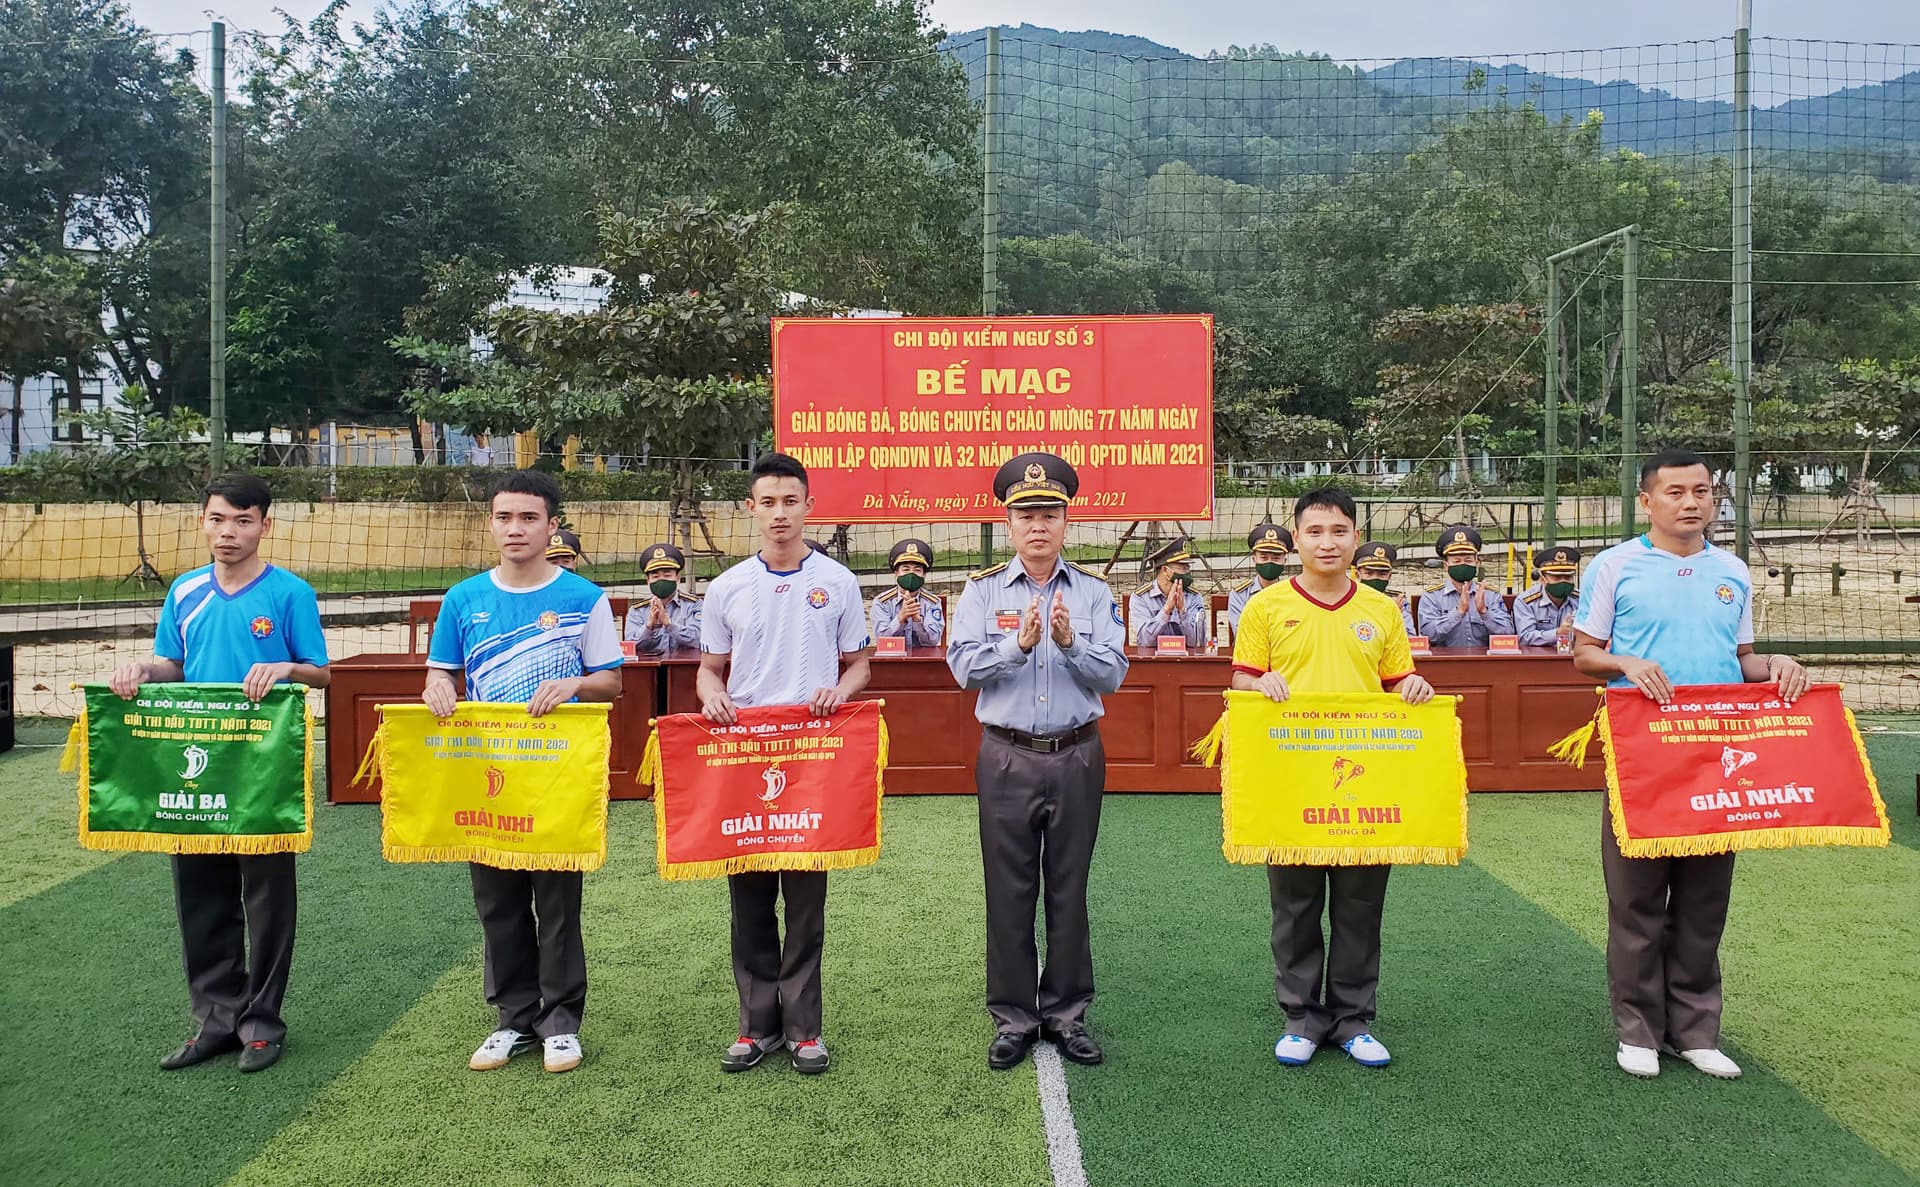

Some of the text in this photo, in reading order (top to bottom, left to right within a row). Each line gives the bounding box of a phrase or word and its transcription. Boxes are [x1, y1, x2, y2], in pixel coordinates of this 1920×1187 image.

[893, 325, 1094, 350] CHI ĐỘI KIỂM NGƯ SỐ 3
[916, 360, 1071, 400] BẾ MẠC
[791, 402, 1198, 435] GIẢI BÓNG ĐÁ, BÓNG CHUYỀN CHÀO MỪNG 77 NĂM NGÀY
[837, 442, 865, 472] LẬP
[869, 446, 930, 470] QĐNDVN
[933, 441, 953, 467] VÀ
[957, 446, 975, 467] 32
[979, 440, 1013, 467] NĂM
[1061, 440, 1085, 471] HỘI
[1089, 444, 1127, 469] QPTD
[1131, 439, 1166, 466] NĂM
[1169, 443, 1204, 466] 2021
[863, 494, 883, 509] Đà
[888, 490, 930, 512] Nẵng,
[935, 494, 968, 511] ngày
[973, 493, 988, 508] 13
[1092, 491, 1127, 507] 2021
[253, 703, 260, 711] 3
[1282, 711, 1299, 719] CHI
[1660, 703, 1679, 713] CHI
[1681, 703, 1702, 713] ĐỘI
[1737, 702, 1760, 711] NGƯ
[1763, 700, 1780, 709] SỐ
[124, 712, 142, 726] GIẢI
[144, 715, 162, 727] THI
[188, 717, 218, 730] TDTT
[220, 717, 247, 731] NĂM
[249, 718, 273, 731] 2021
[710, 726, 727, 735] CHI
[1649, 717, 1672, 733] GIẢI
[1674, 719, 1695, 731] THI
[1721, 718, 1751, 731] TDTT
[1754, 715, 1785, 730] NĂM
[1786, 715, 1813, 727] 2021
[1294, 727, 1310, 739] THI
[1338, 727, 1367, 739] TDTT
[1400, 728, 1423, 740] 2021
[546, 739, 568, 750] 2021
[697, 741, 718, 755] GIẢI
[763, 739, 792, 751] TDTT
[794, 737, 819, 750] NĂM
[821, 736, 844, 748] 2021
[159, 789, 227, 810] GIẢI BA
[1690, 788, 1741, 811] GIẢI
[1745, 782, 1815, 807] NHẤT
[155, 810, 183, 820] BÓNG
[454, 807, 534, 833] GIẢI NHÌ
[721, 808, 822, 835] GIẢI NHẤT
[1303, 803, 1401, 824] GIẢI NHÌ
[1726, 809, 1782, 822] BÓNG ĐÁ
[737, 836, 765, 846] BÓNG
[1362, 827, 1376, 836] ĐÁ
